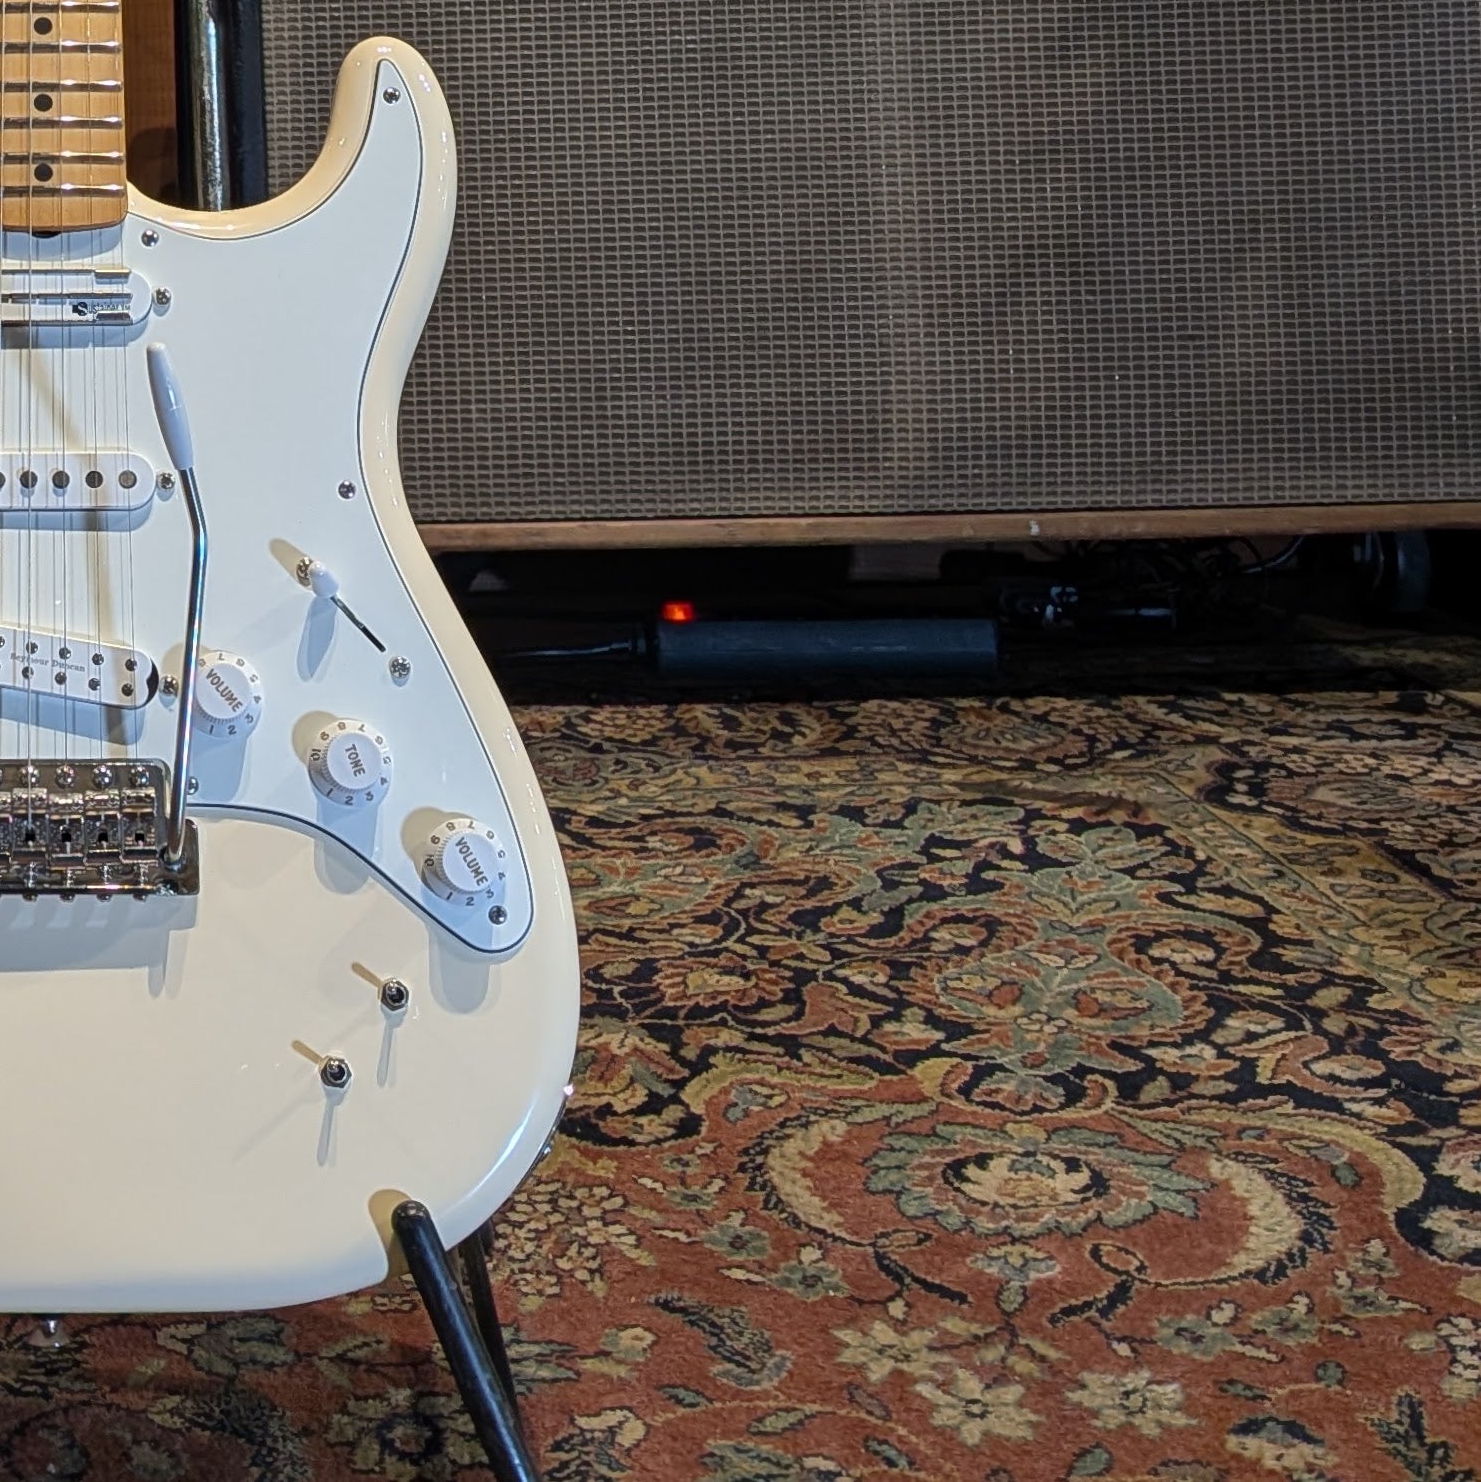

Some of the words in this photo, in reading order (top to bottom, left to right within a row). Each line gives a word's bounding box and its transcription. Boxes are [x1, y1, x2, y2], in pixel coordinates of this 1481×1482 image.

[51, 658, 86, 673] Duncan
[205, 668, 244, 713] VOLUME
[227, 725, 237, 735] 2
[344, 743, 367, 778] TONE
[344, 795, 354, 806] 2
[455, 836, 489, 887] VOLUME
[465, 896, 475, 906] 2
